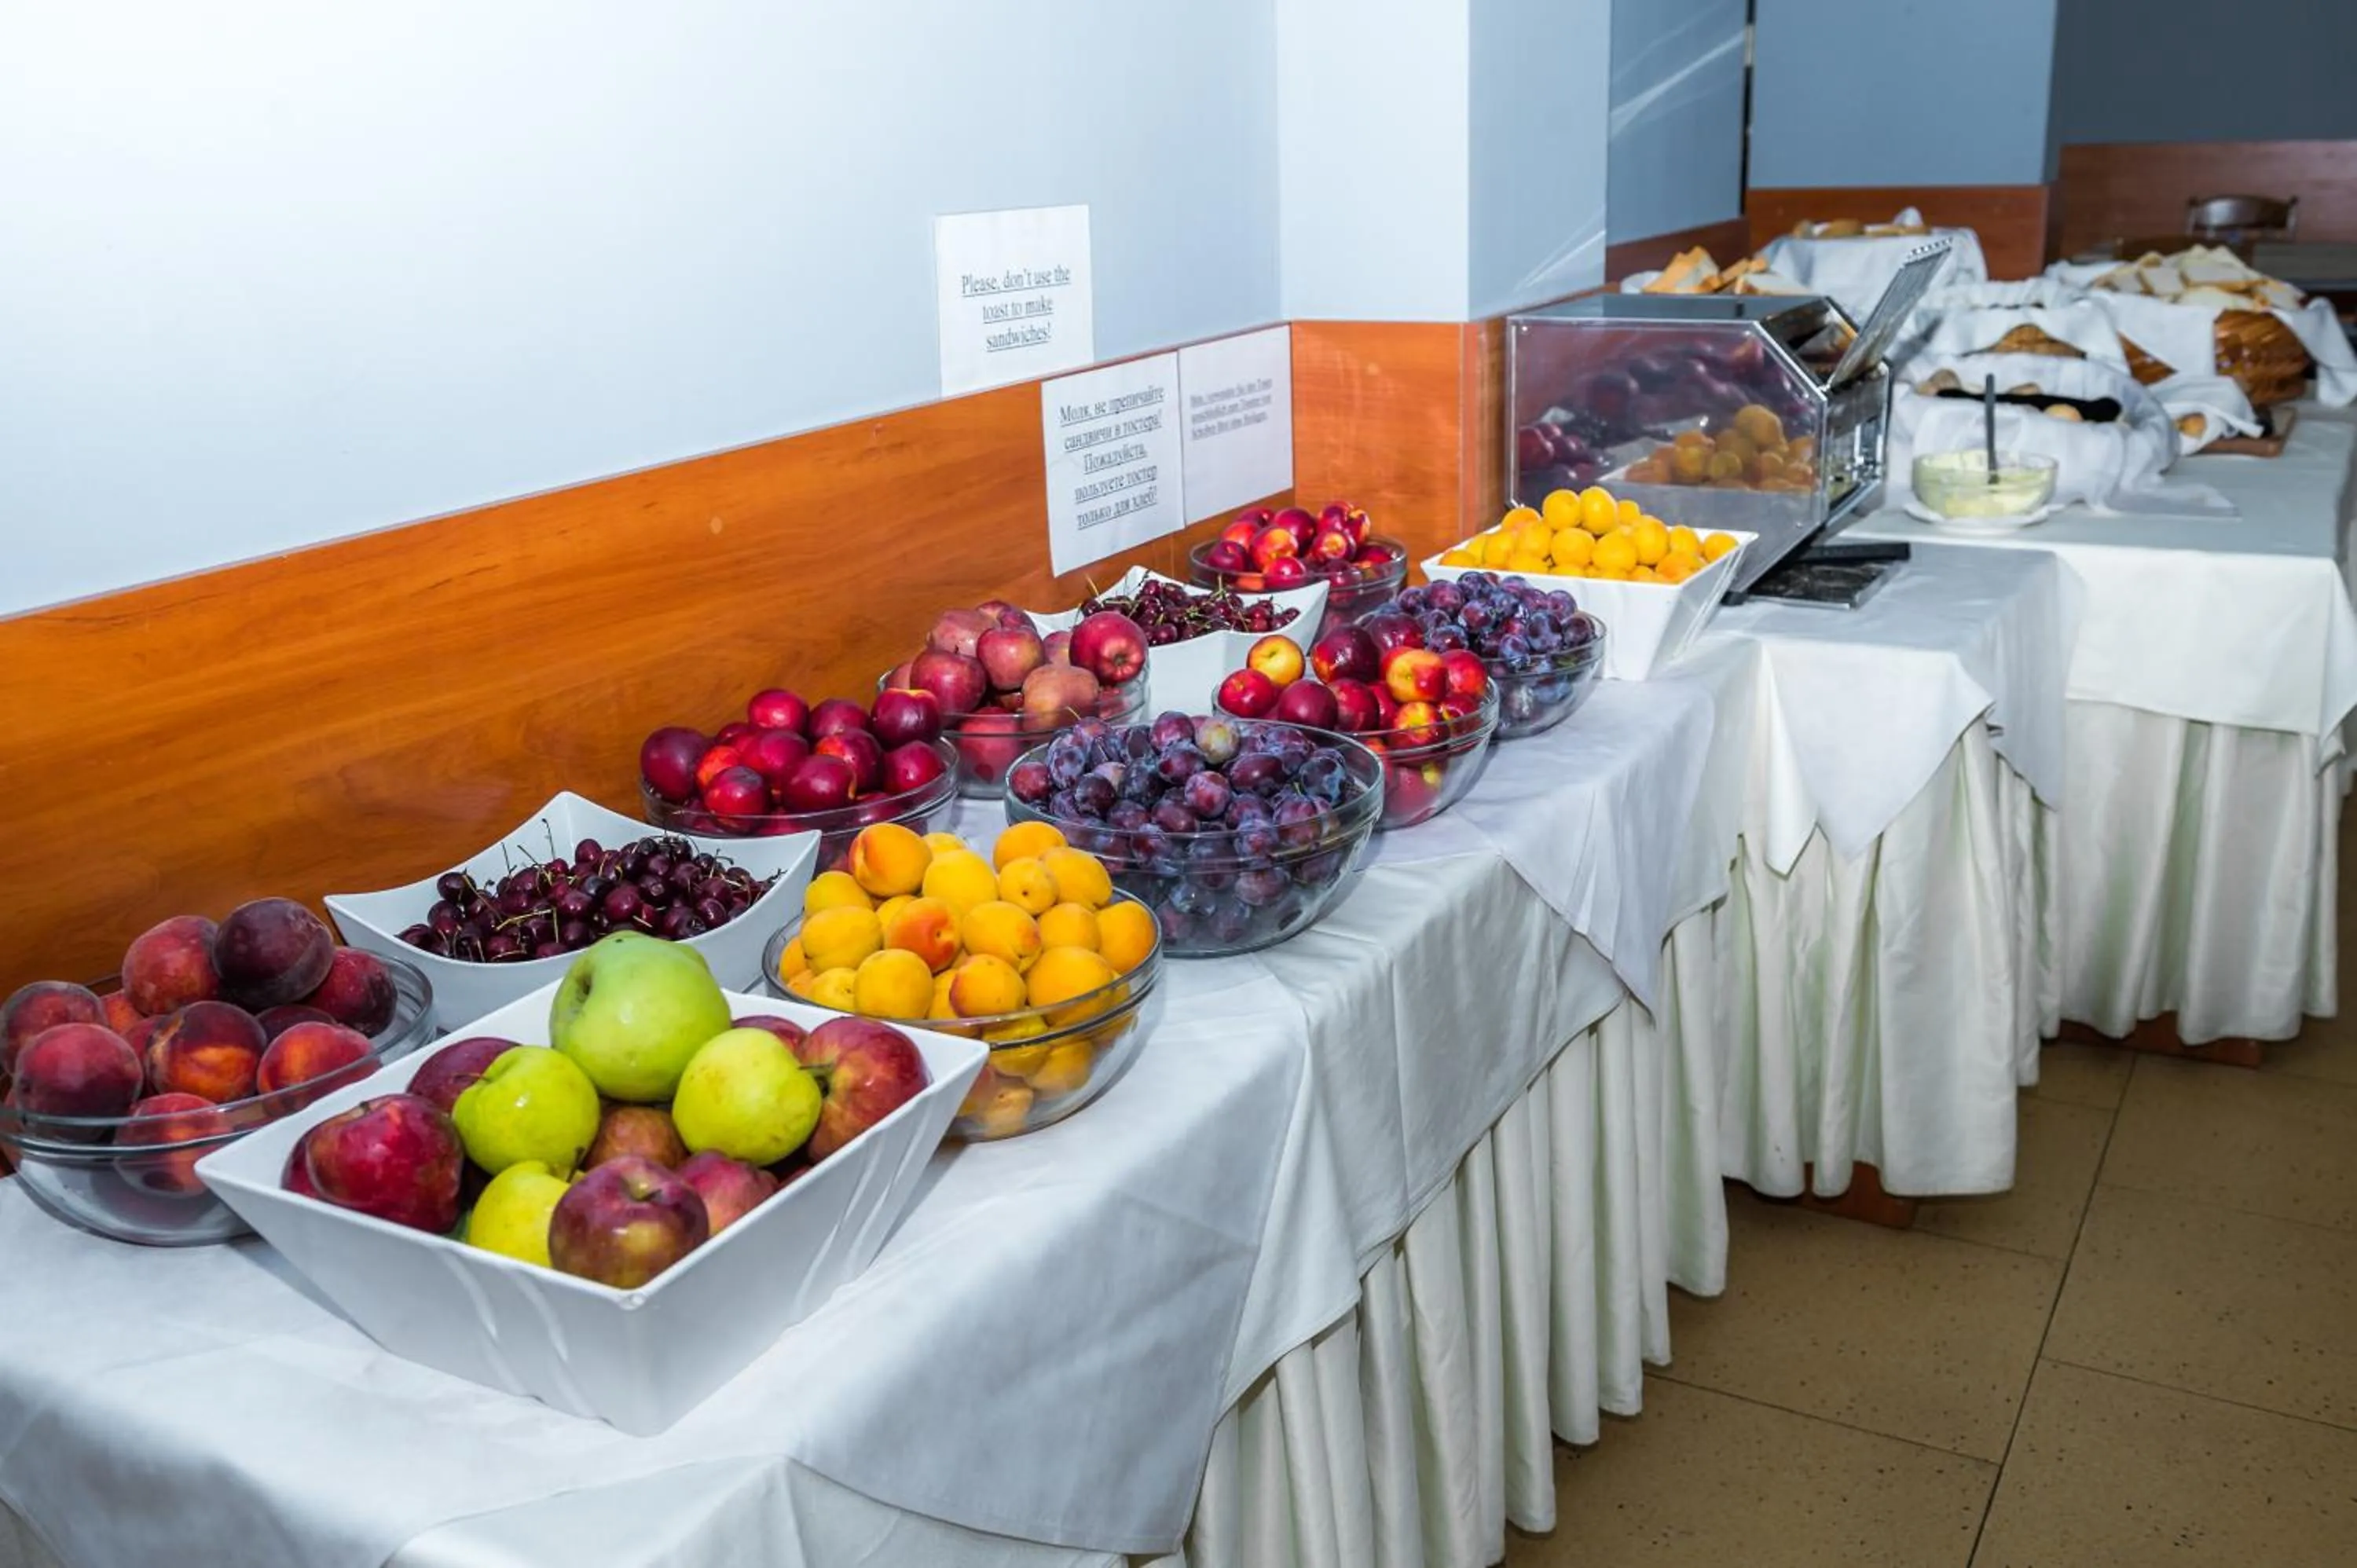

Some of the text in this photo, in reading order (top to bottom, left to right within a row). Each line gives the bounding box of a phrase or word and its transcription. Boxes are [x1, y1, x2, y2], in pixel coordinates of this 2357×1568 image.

[962, 274, 1000, 294] Please,
[1034, 273, 1052, 285] use
[1054, 264, 1070, 282] the
[982, 295, 1054, 321] toast to make
[985, 322, 1052, 350] sandwiches!
[1094, 401, 1106, 415] не
[1065, 426, 1112, 450] сандвичи
[1115, 424, 1121, 436] в
[1077, 506, 1112, 527] только
[1114, 499, 1130, 515] для
